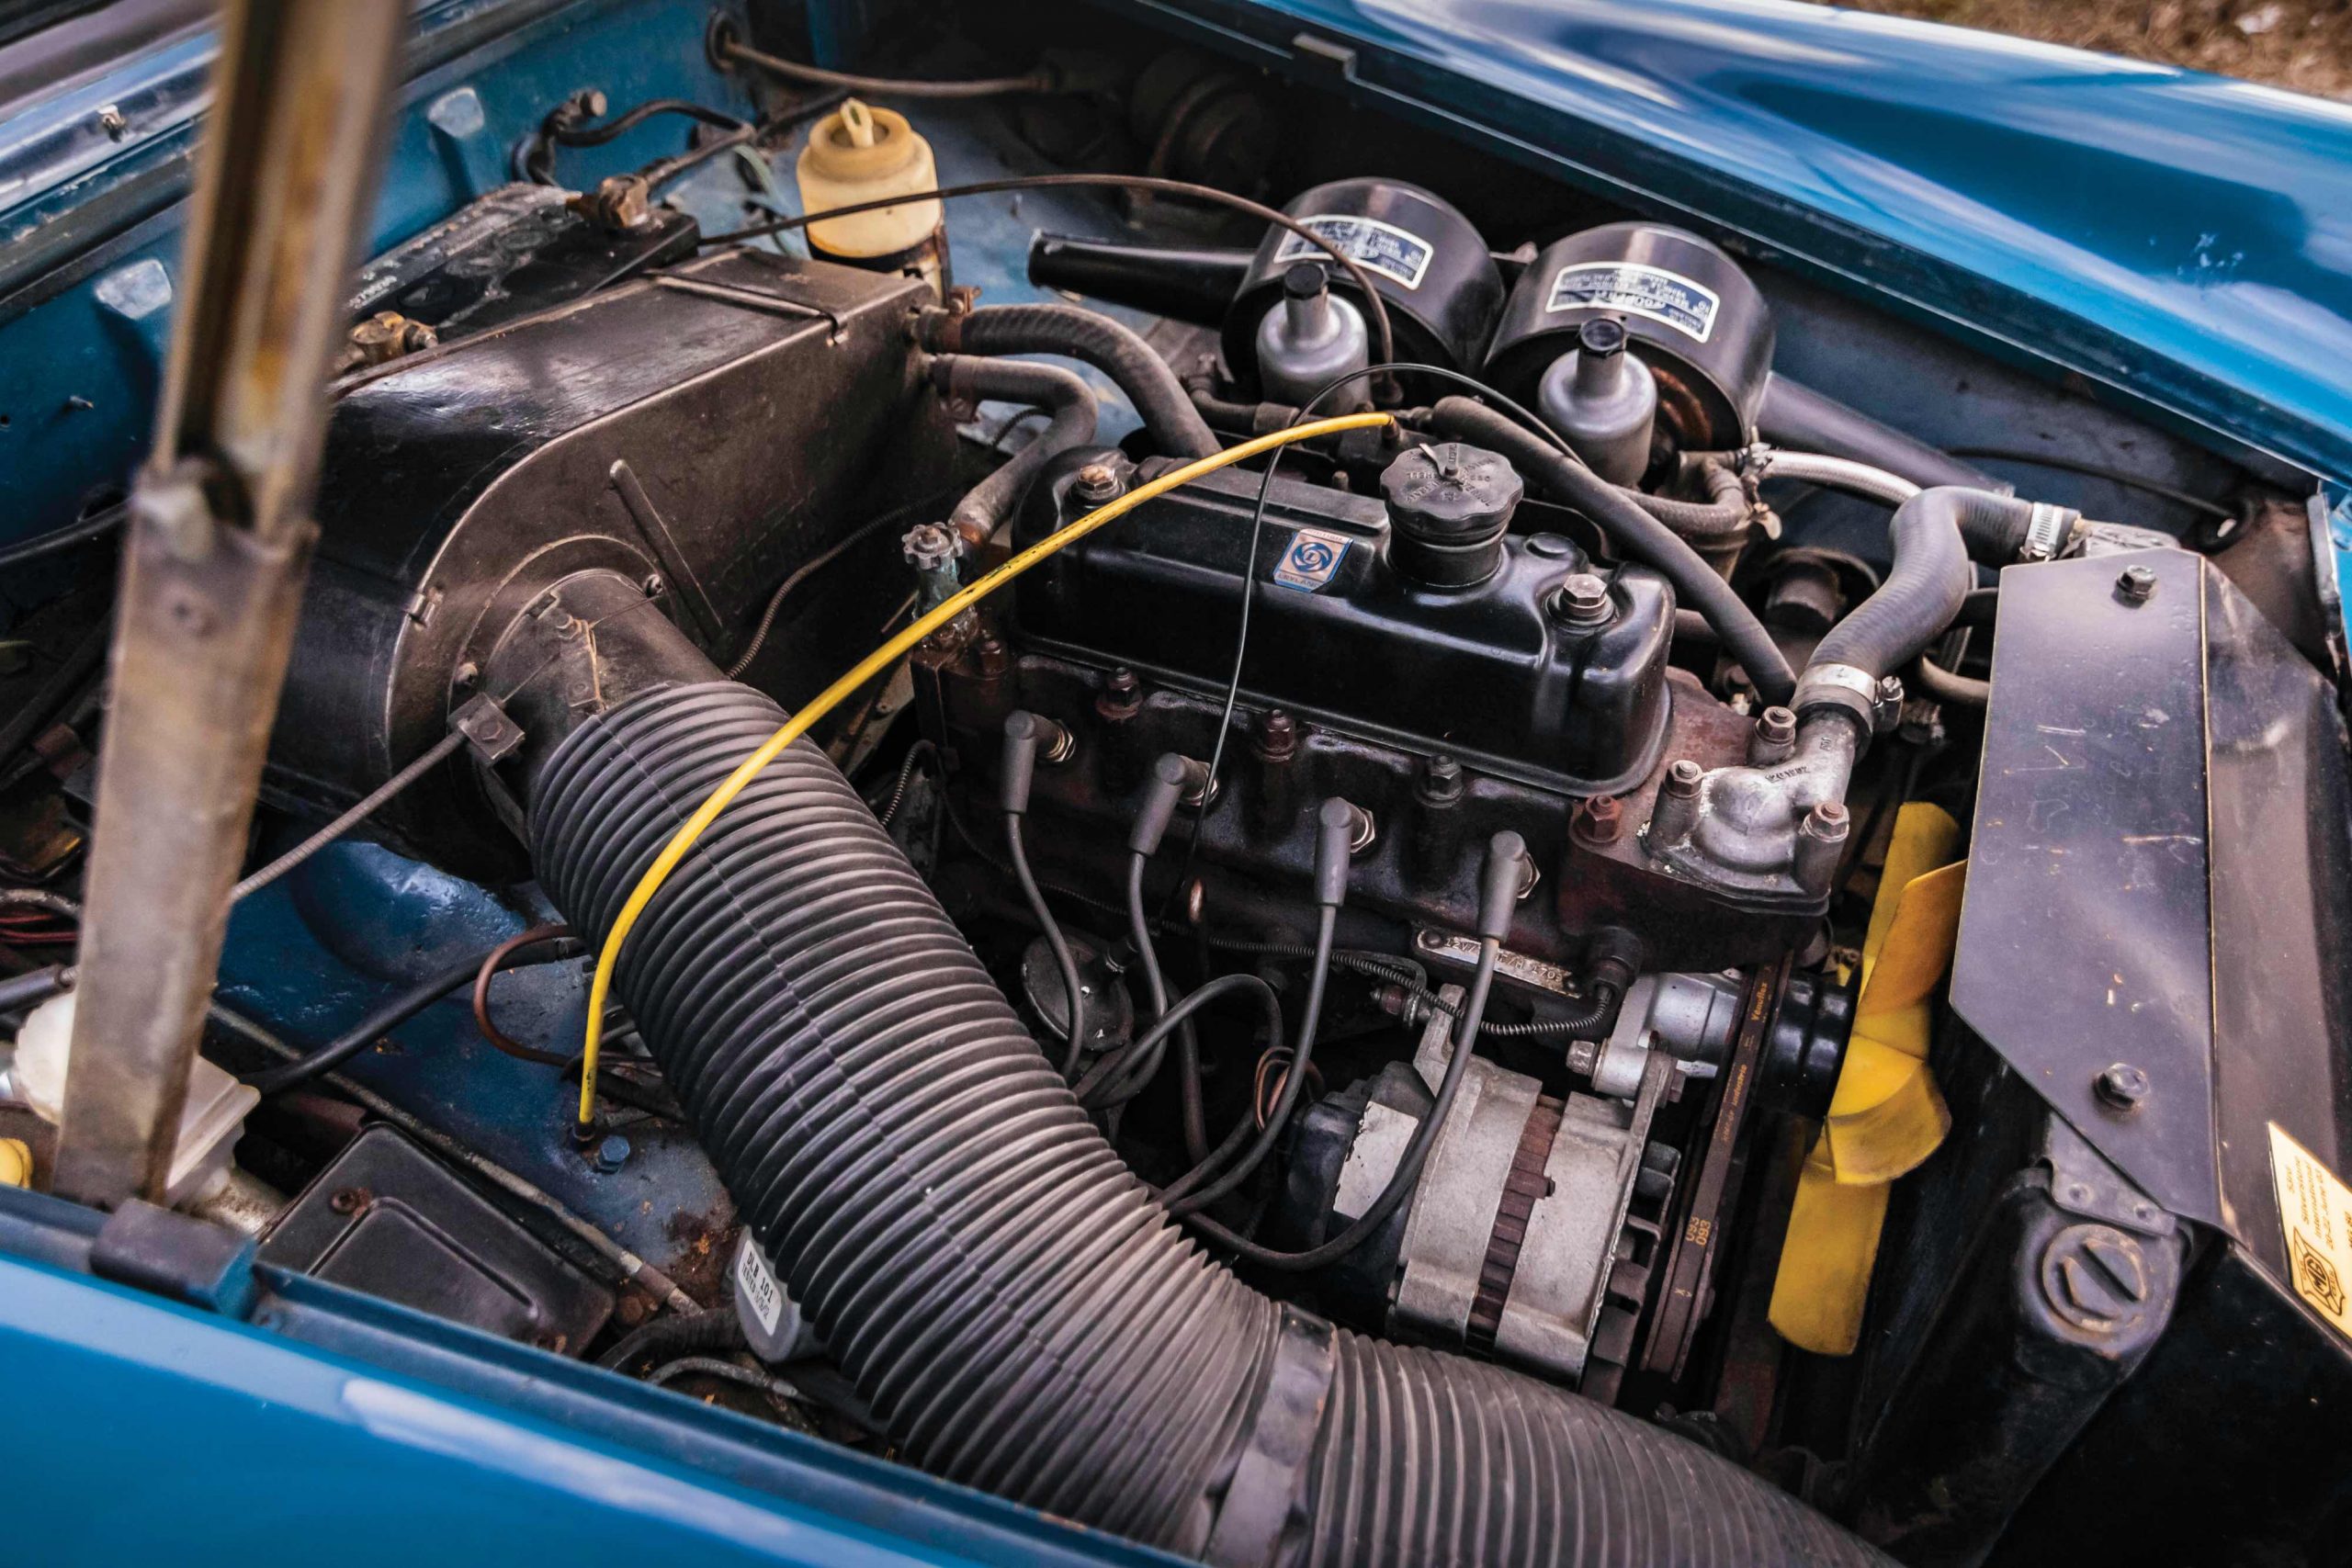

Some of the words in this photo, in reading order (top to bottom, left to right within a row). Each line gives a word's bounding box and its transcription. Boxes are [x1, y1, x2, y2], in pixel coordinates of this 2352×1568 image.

[2295, 1156, 2310, 1225] Silverstone
[2305, 1159, 2322, 1239] International
[1696, 1219, 1712, 1246] 093
[760, 1276, 774, 1303] 101
[2306, 1258, 2328, 1292] MG
